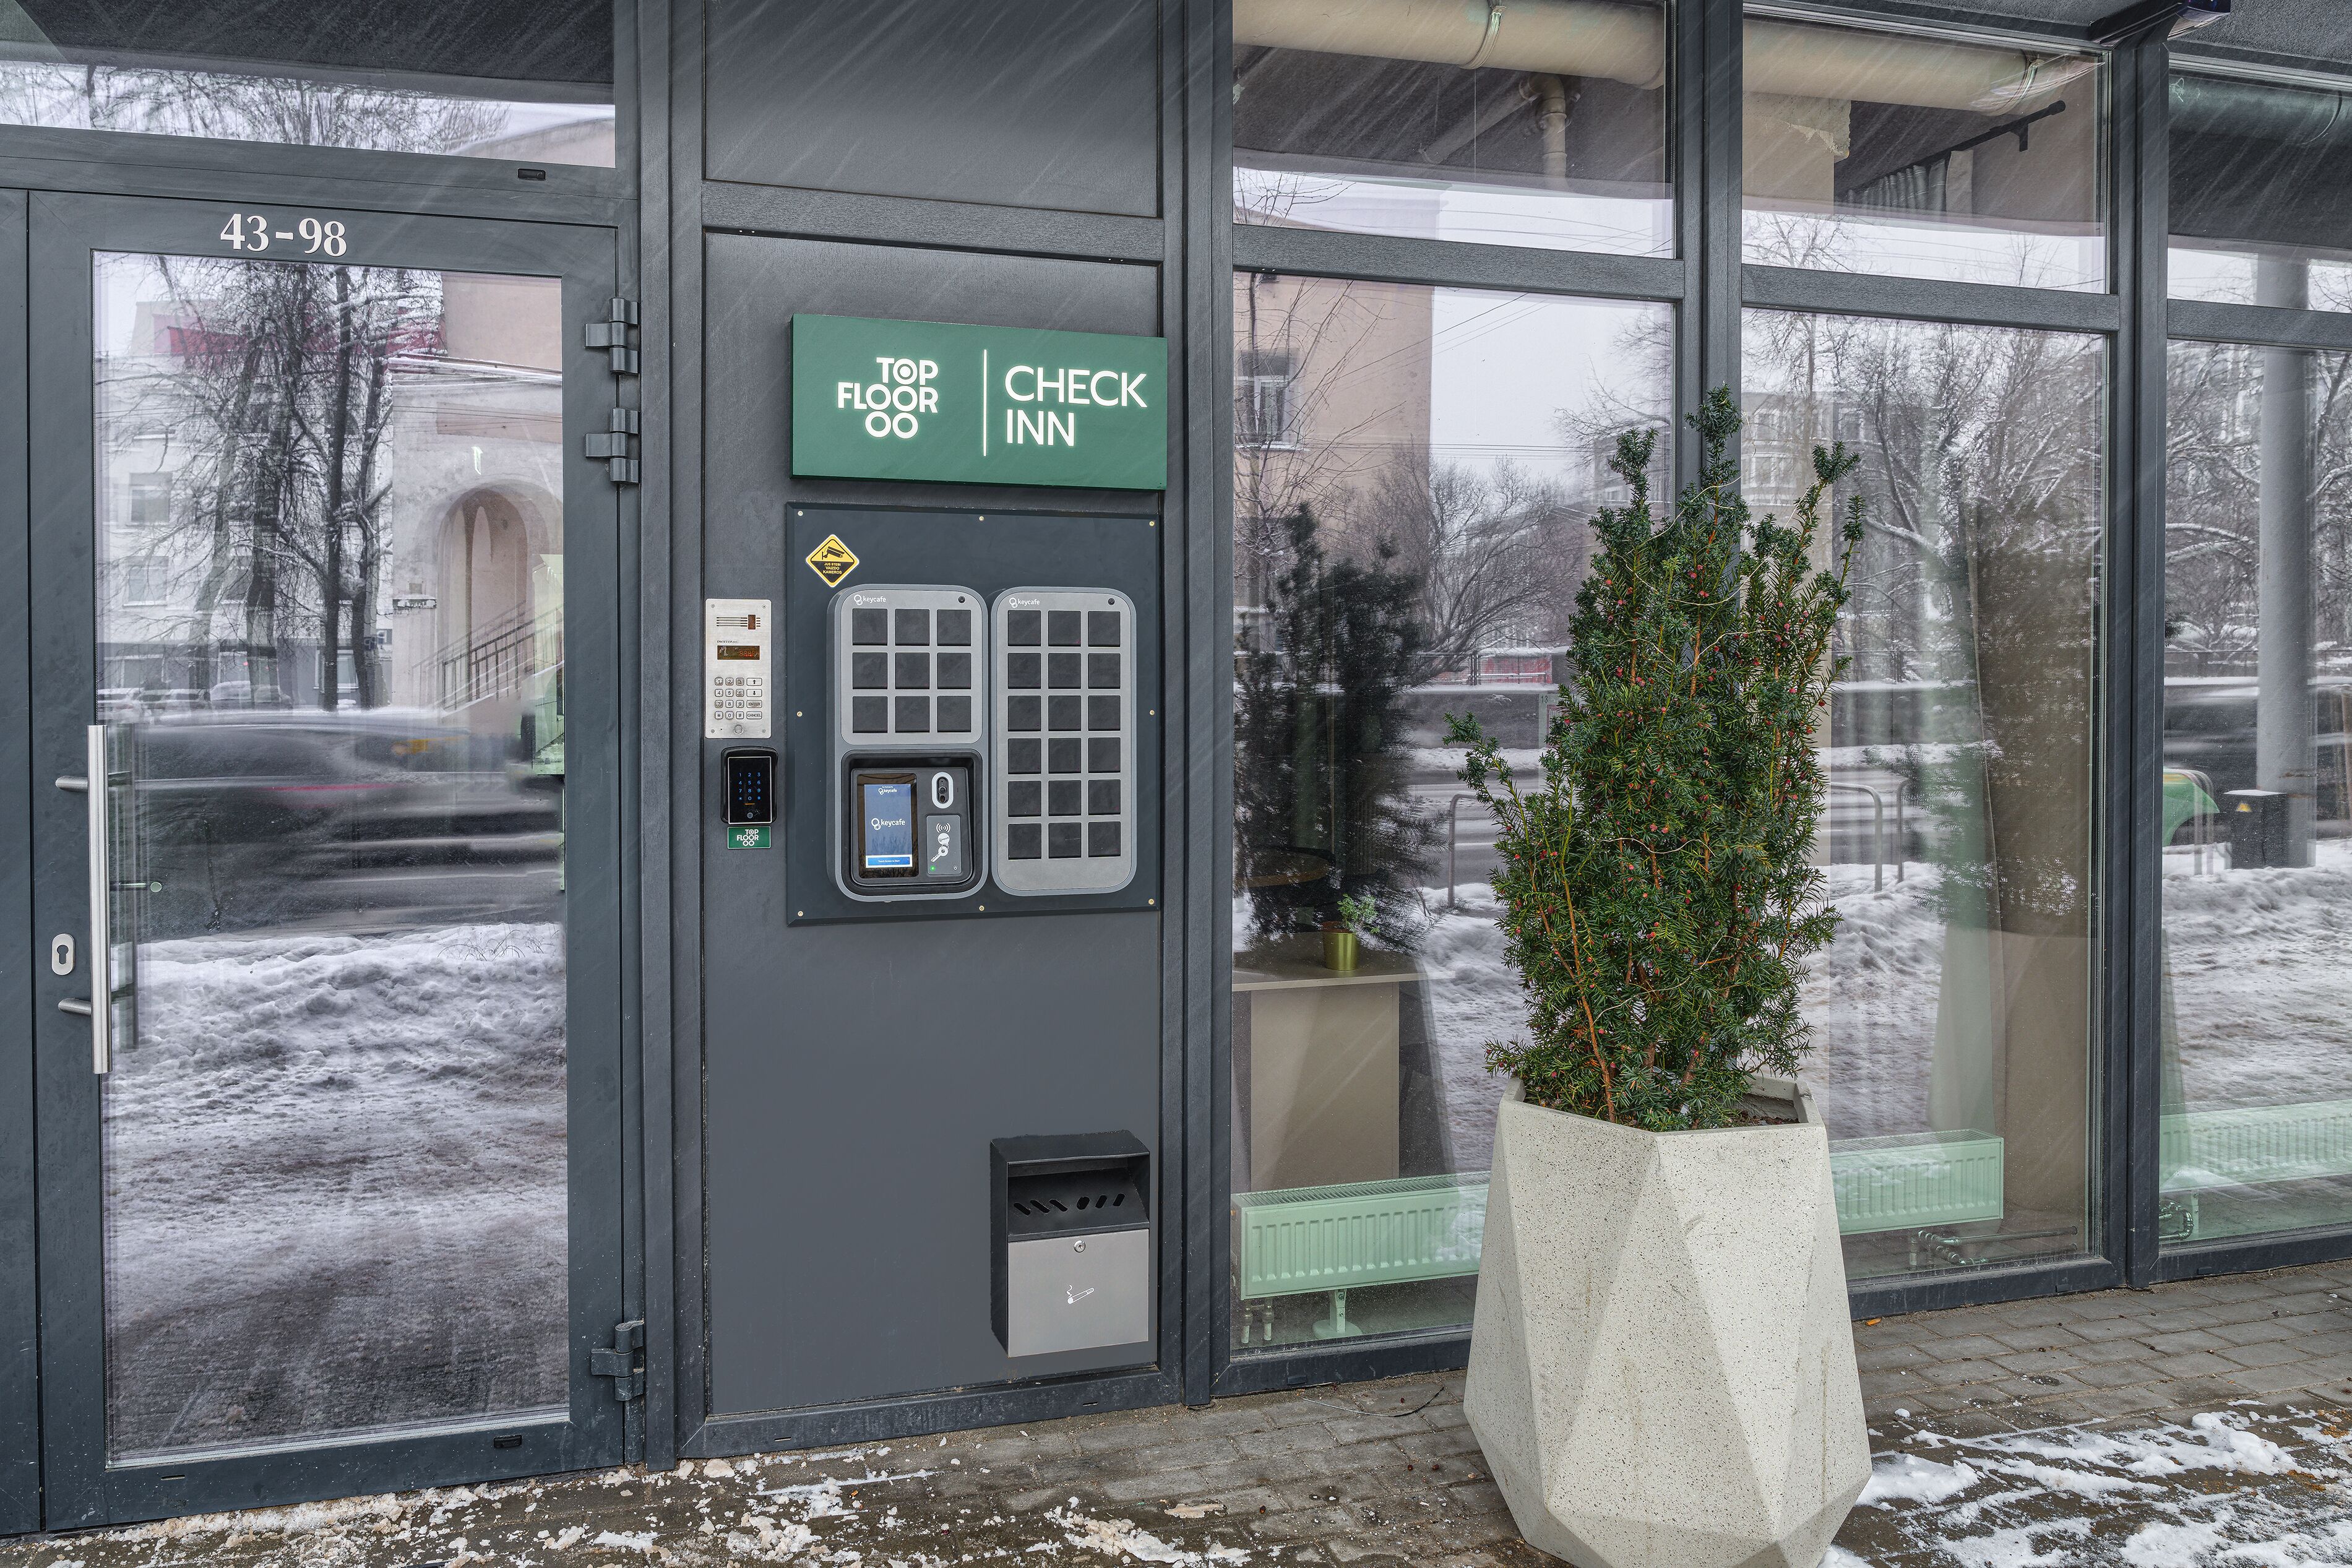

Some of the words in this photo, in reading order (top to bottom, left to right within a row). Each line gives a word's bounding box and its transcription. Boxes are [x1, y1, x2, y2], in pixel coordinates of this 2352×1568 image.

[220, 213, 347, 257] 43-98
[876, 357, 939, 386] TOP
[1004, 365, 1148, 408] CHECK
[837, 381, 939, 413] FLOOR
[1006, 409, 1075, 447] INN
[881, 819, 905, 827] keycafe
